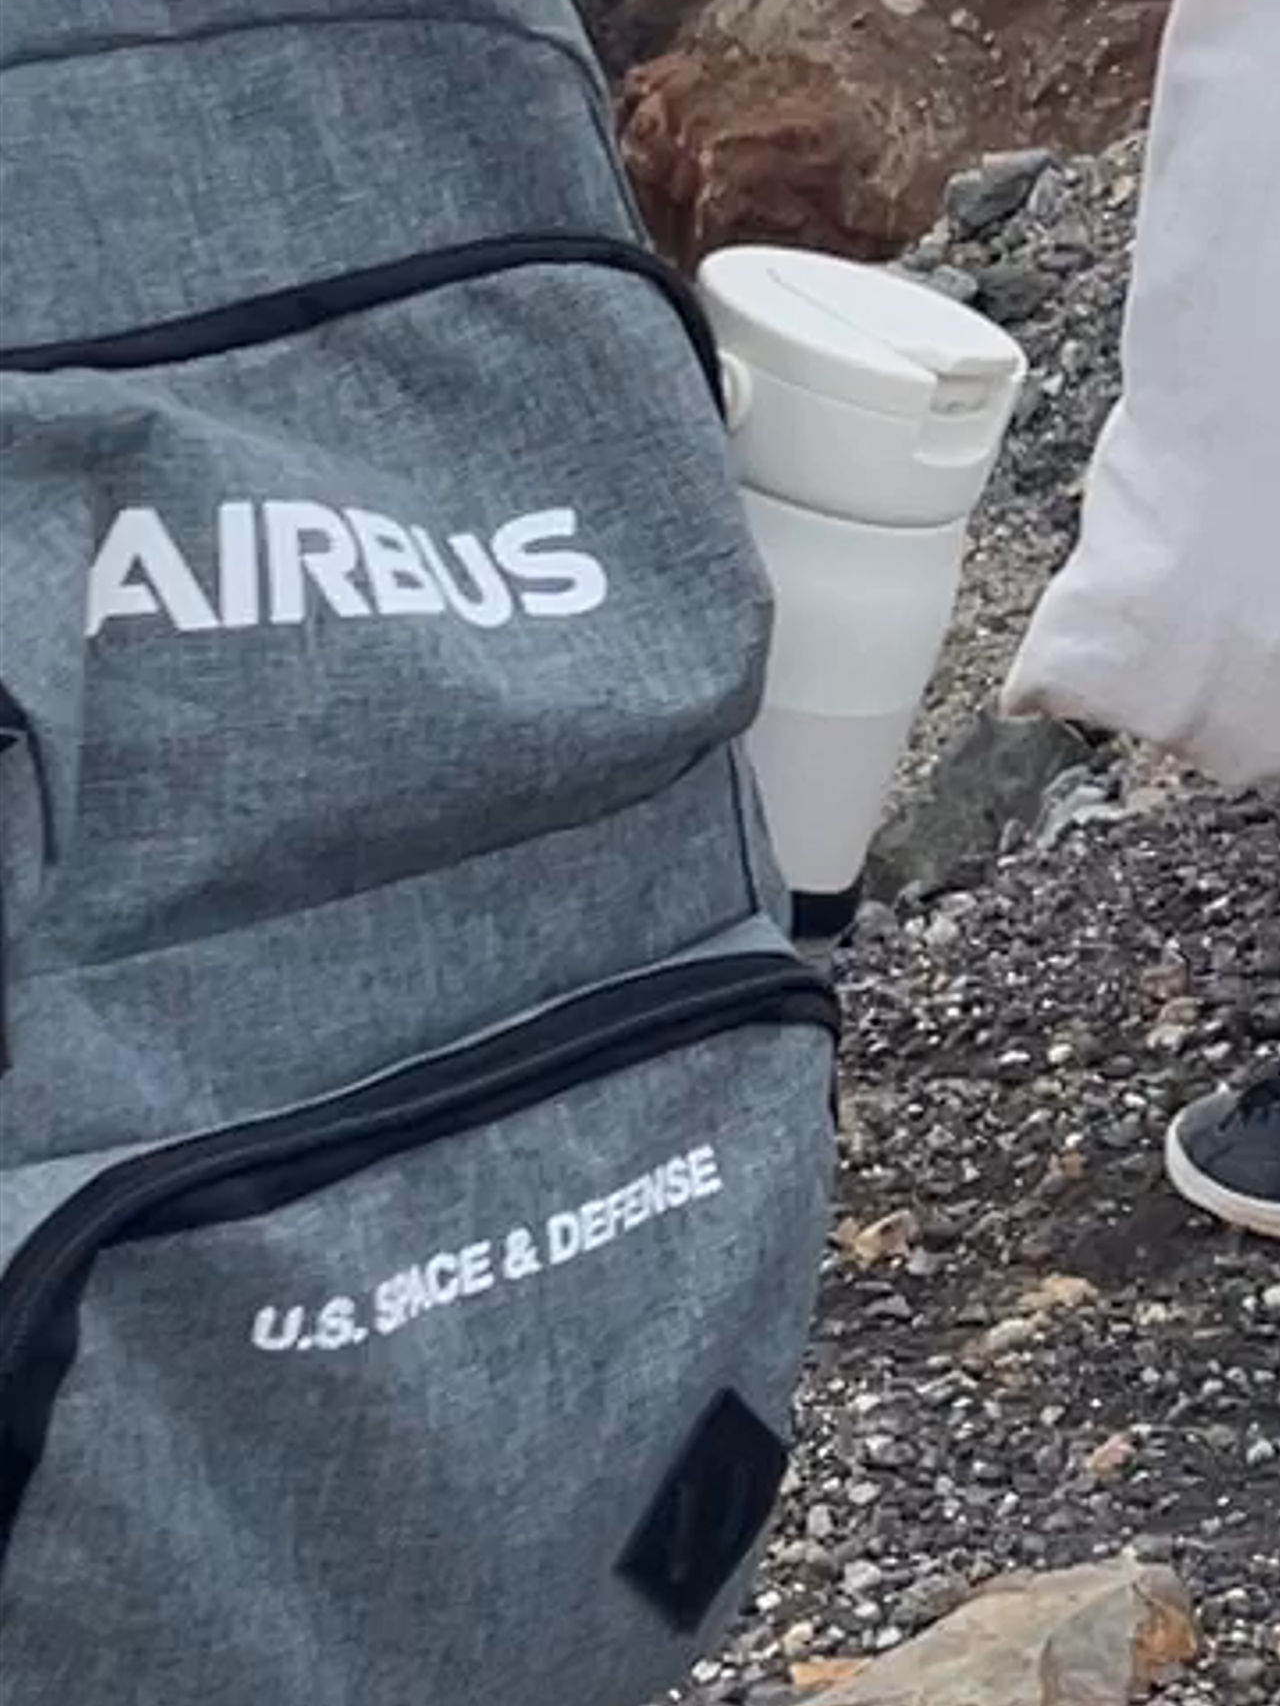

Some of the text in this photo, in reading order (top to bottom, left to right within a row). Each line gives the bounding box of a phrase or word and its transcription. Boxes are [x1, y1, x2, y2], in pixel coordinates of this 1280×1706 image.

[85, 499, 608, 637] AIRBUS
[250, 1143, 723, 1351] U.S. SPACE & DEFENSE
